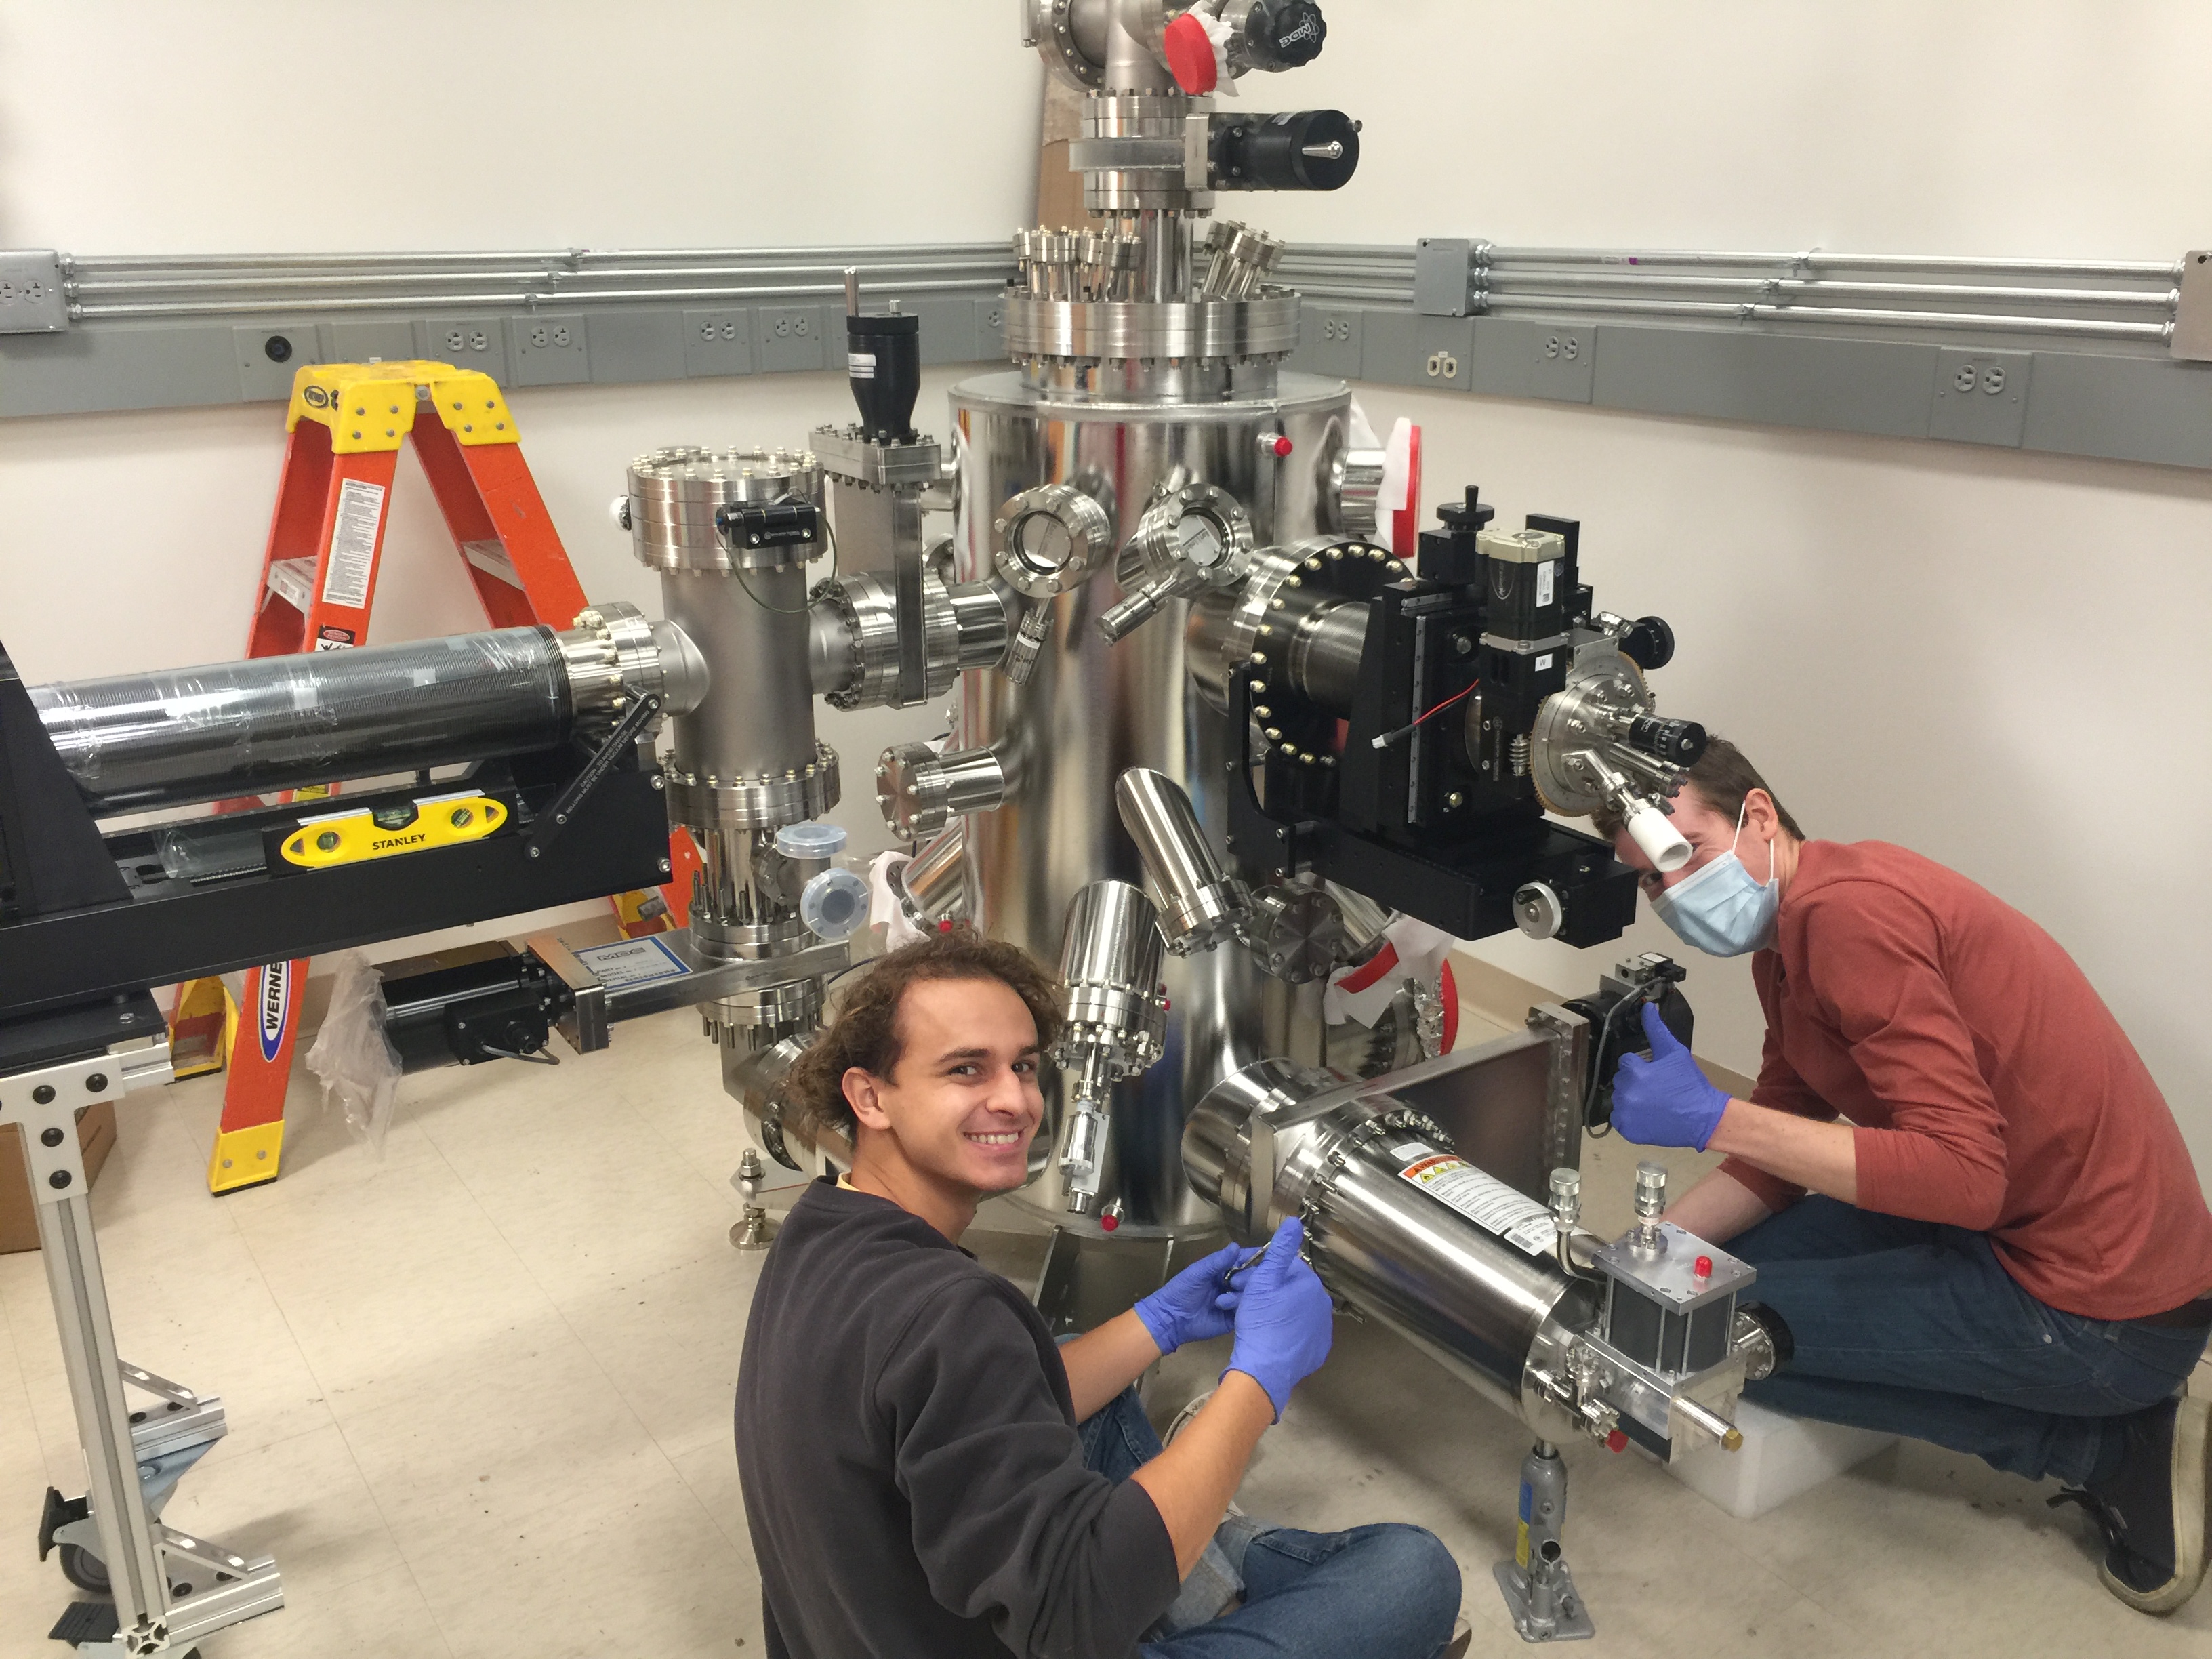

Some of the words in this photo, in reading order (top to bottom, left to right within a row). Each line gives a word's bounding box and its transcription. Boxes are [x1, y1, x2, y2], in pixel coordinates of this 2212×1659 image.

[1279, 23, 1313, 48] MDC
[1540, 658, 1547, 666] W
[601, 747, 613, 761] AVOID
[611, 729, 628, 748] DAMAGE
[565, 793, 583, 814] BELLOWS
[581, 781, 593, 794] MUST
[596, 760, 610, 776] UNDER
[609, 743, 623, 761] VACUUM
[621, 726, 637, 744] BEFORE
[634, 710, 650, 728] MOVING
[372, 833, 426, 851] STANLEY
[596, 947, 647, 961] MDC
